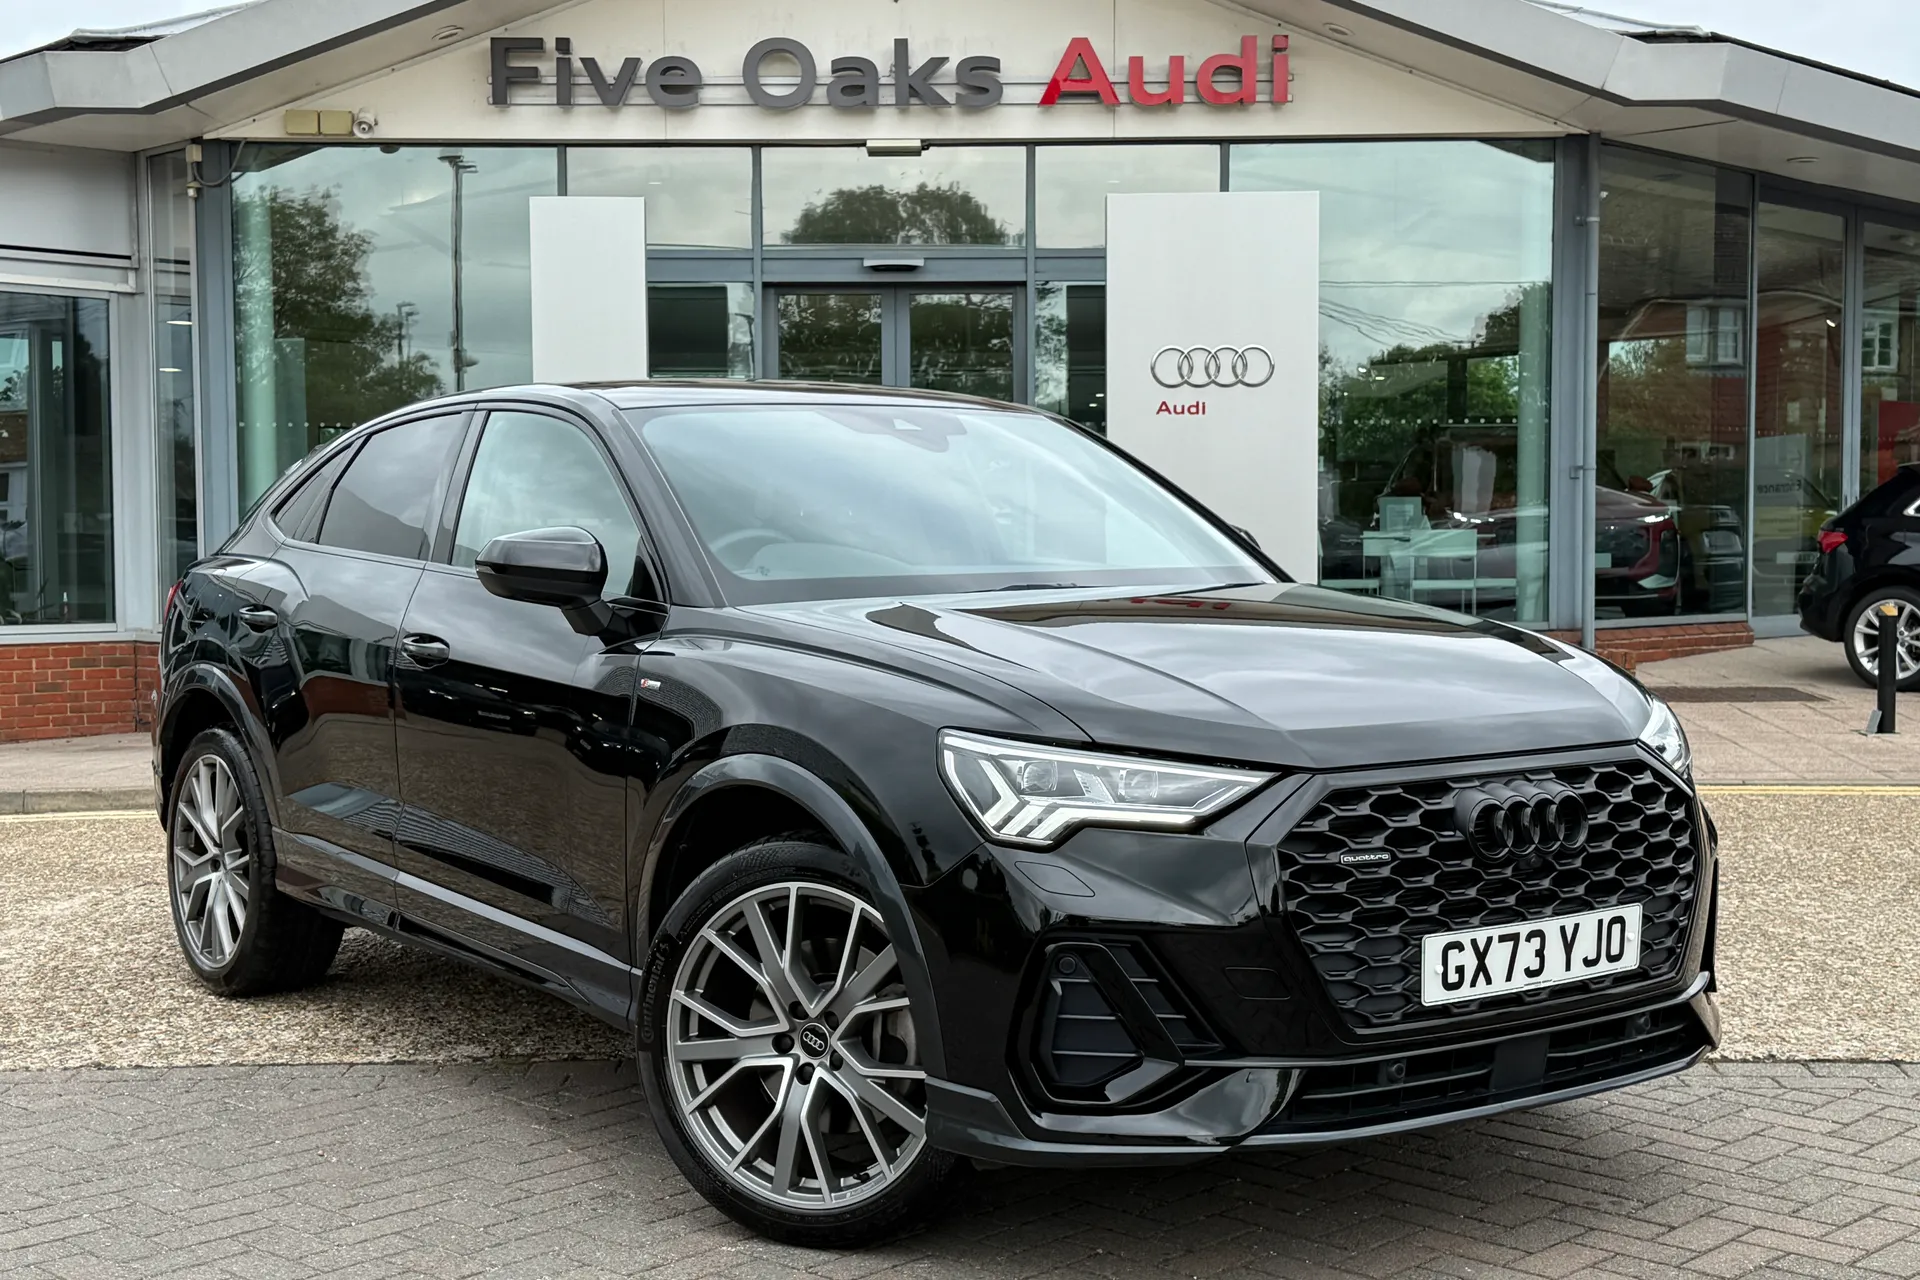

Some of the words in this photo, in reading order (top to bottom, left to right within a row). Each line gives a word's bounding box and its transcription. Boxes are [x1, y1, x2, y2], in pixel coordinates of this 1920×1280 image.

[491, 37, 702, 108] Five
[742, 37, 1003, 109] Oaks
[1038, 35, 1290, 108] Audi
[1156, 401, 1206, 415] Audi
[1343, 854, 1389, 863] quattro
[1441, 929, 1546, 992] GX73
[1559, 915, 1627, 973] YJO
